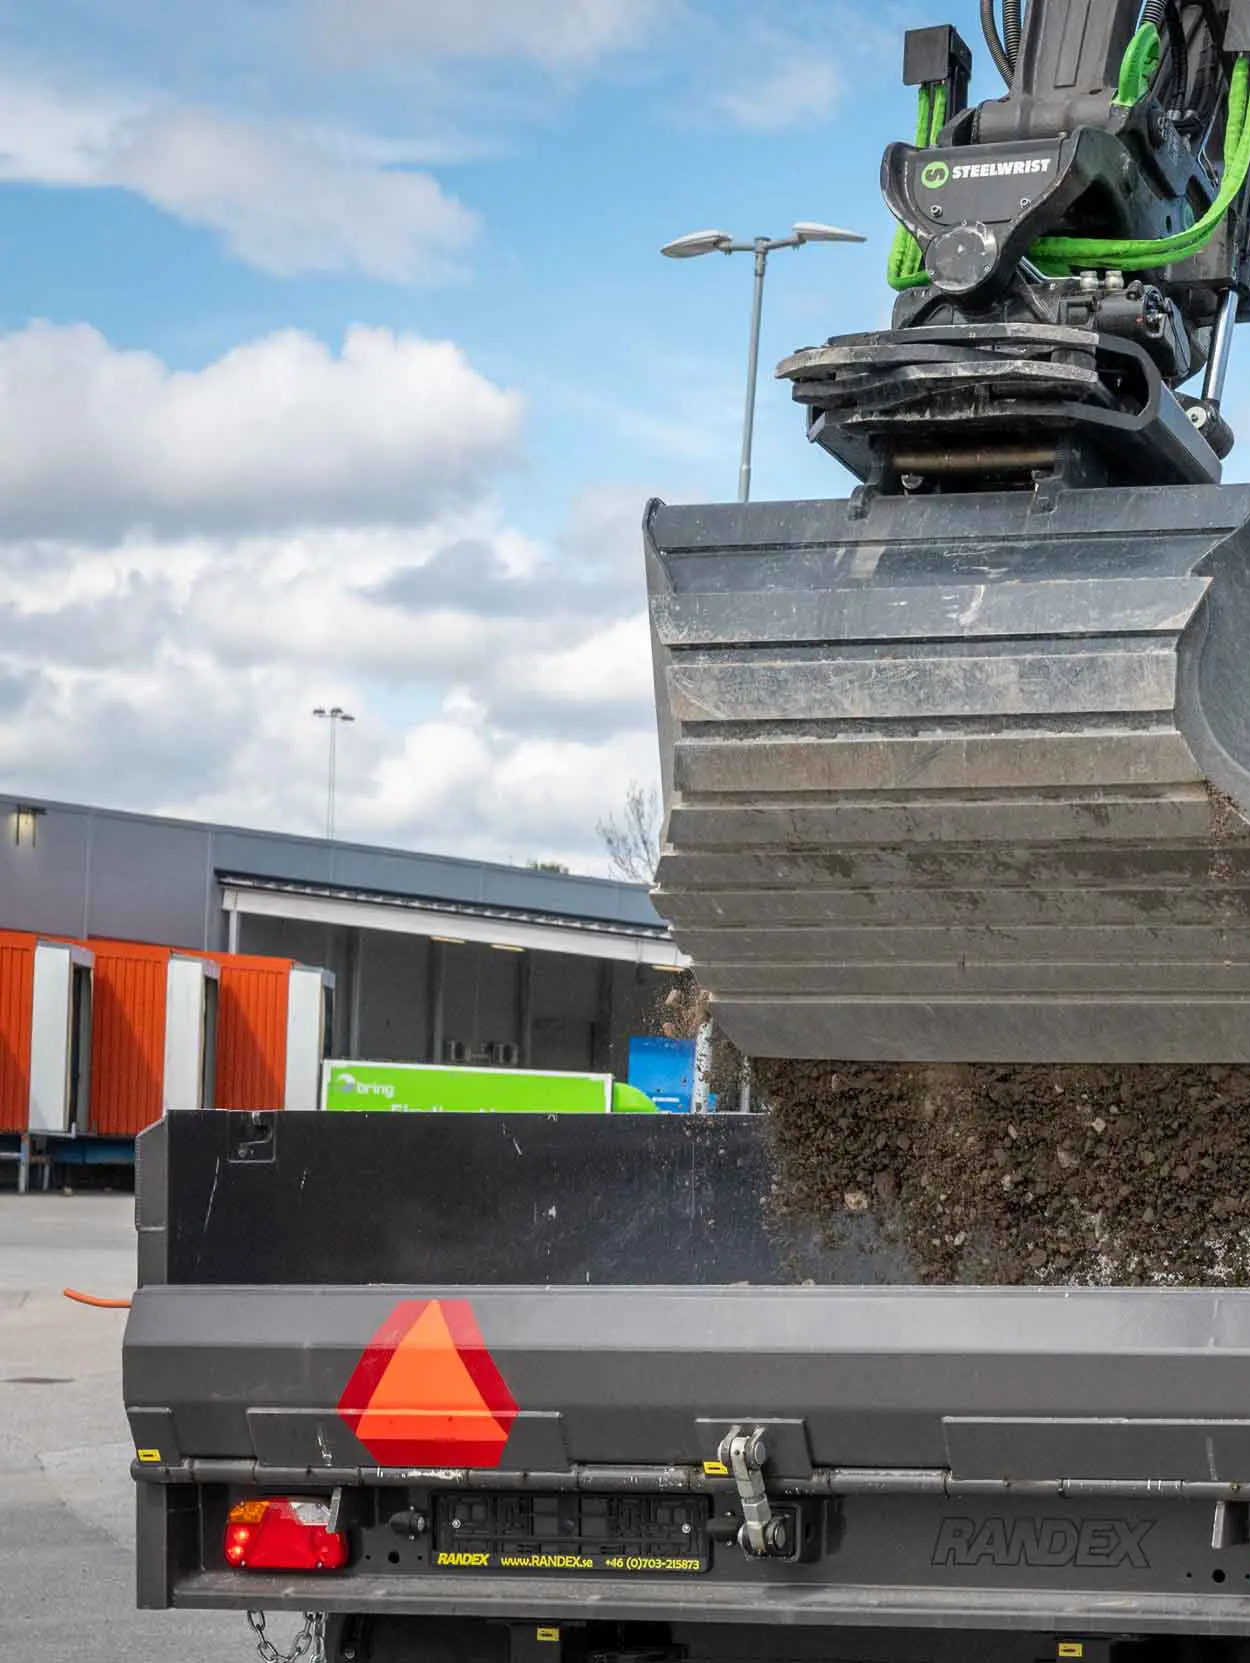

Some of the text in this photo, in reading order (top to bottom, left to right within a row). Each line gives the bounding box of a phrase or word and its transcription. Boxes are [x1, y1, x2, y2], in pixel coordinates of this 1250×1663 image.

[951, 158, 1051, 180] STEELWRIST
[356, 1081, 395, 1099] bring
[931, 1517, 1158, 1569] RANDEX
[437, 1552, 701, 1572] RANDEX www.RANDEX.se +46 (0)703-215873
